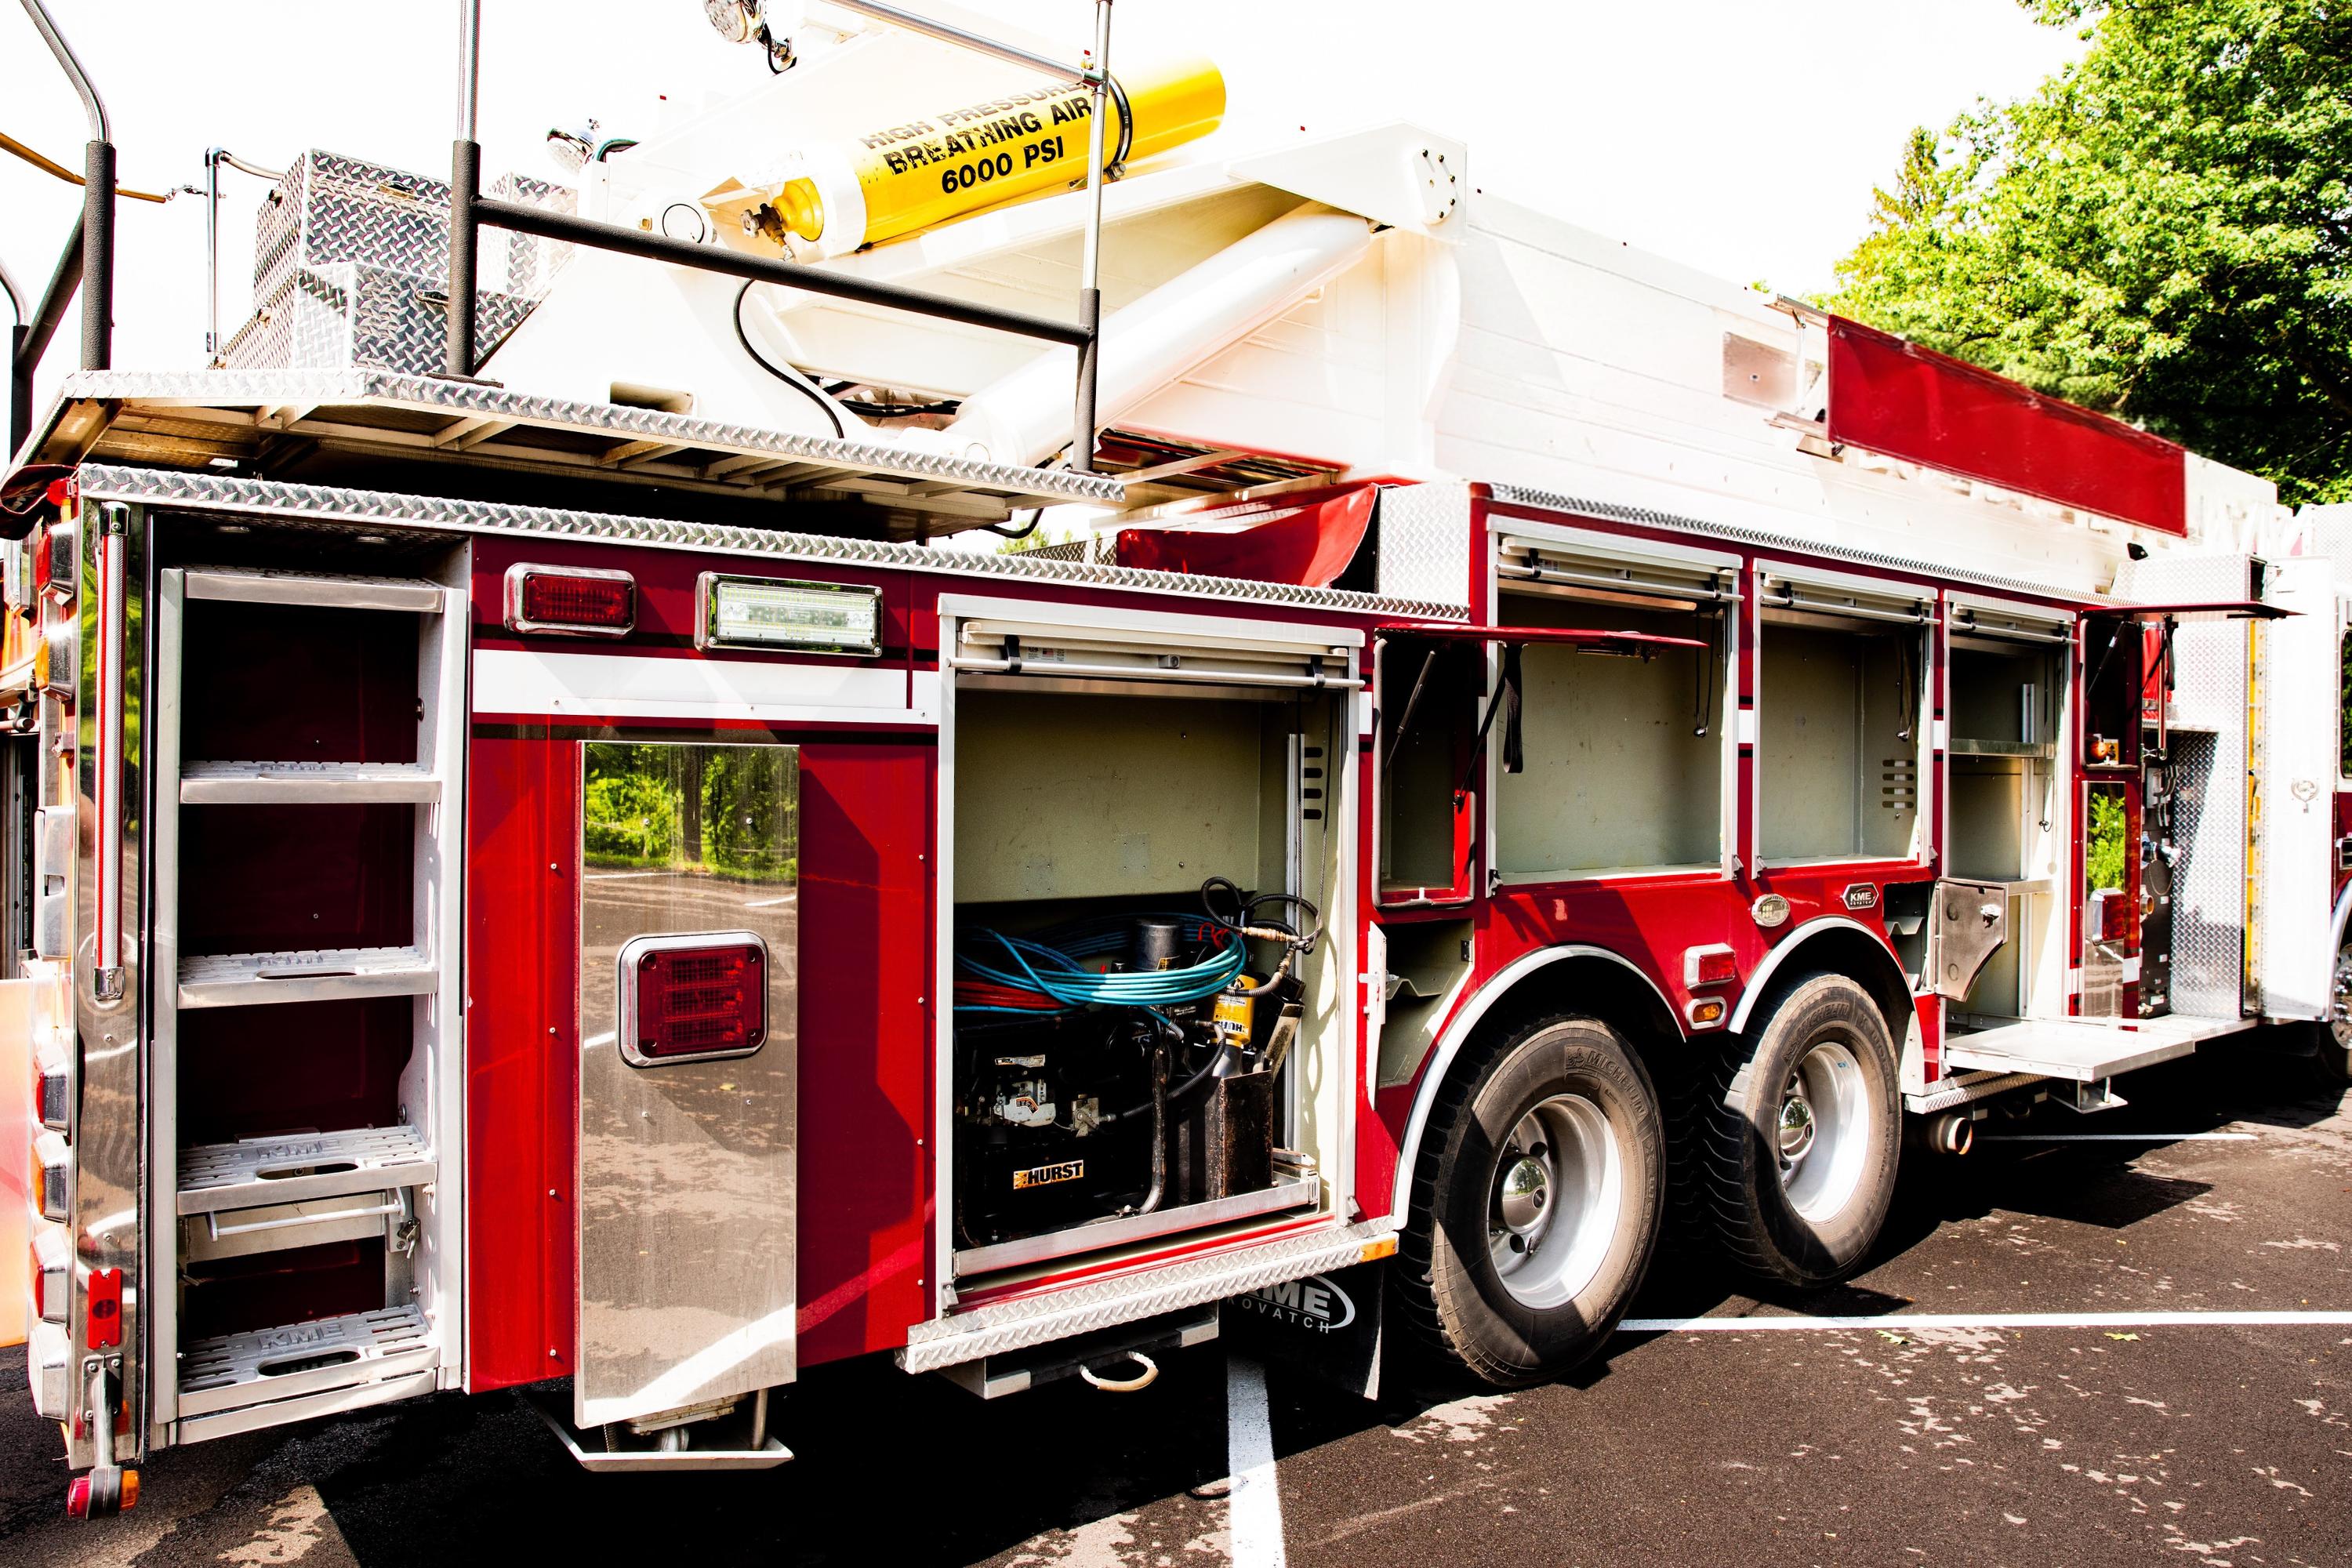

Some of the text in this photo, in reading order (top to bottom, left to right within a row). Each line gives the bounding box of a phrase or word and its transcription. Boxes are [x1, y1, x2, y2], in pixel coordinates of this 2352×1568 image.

[858, 80, 1084, 149] HIGH PRESSURE
[883, 96, 1093, 175] BREATHING AIR
[942, 136, 1065, 194] 6000 PSI
[1850, 892, 1872, 902] KME
[1587, 1050, 1647, 1123] MICHELIN
[1028, 1162, 1083, 1185] HURST
[1227, 1297, 1330, 1334] KOVATCH
[1247, 1281, 1330, 1319] ME
[258, 1323, 344, 1349] KME
